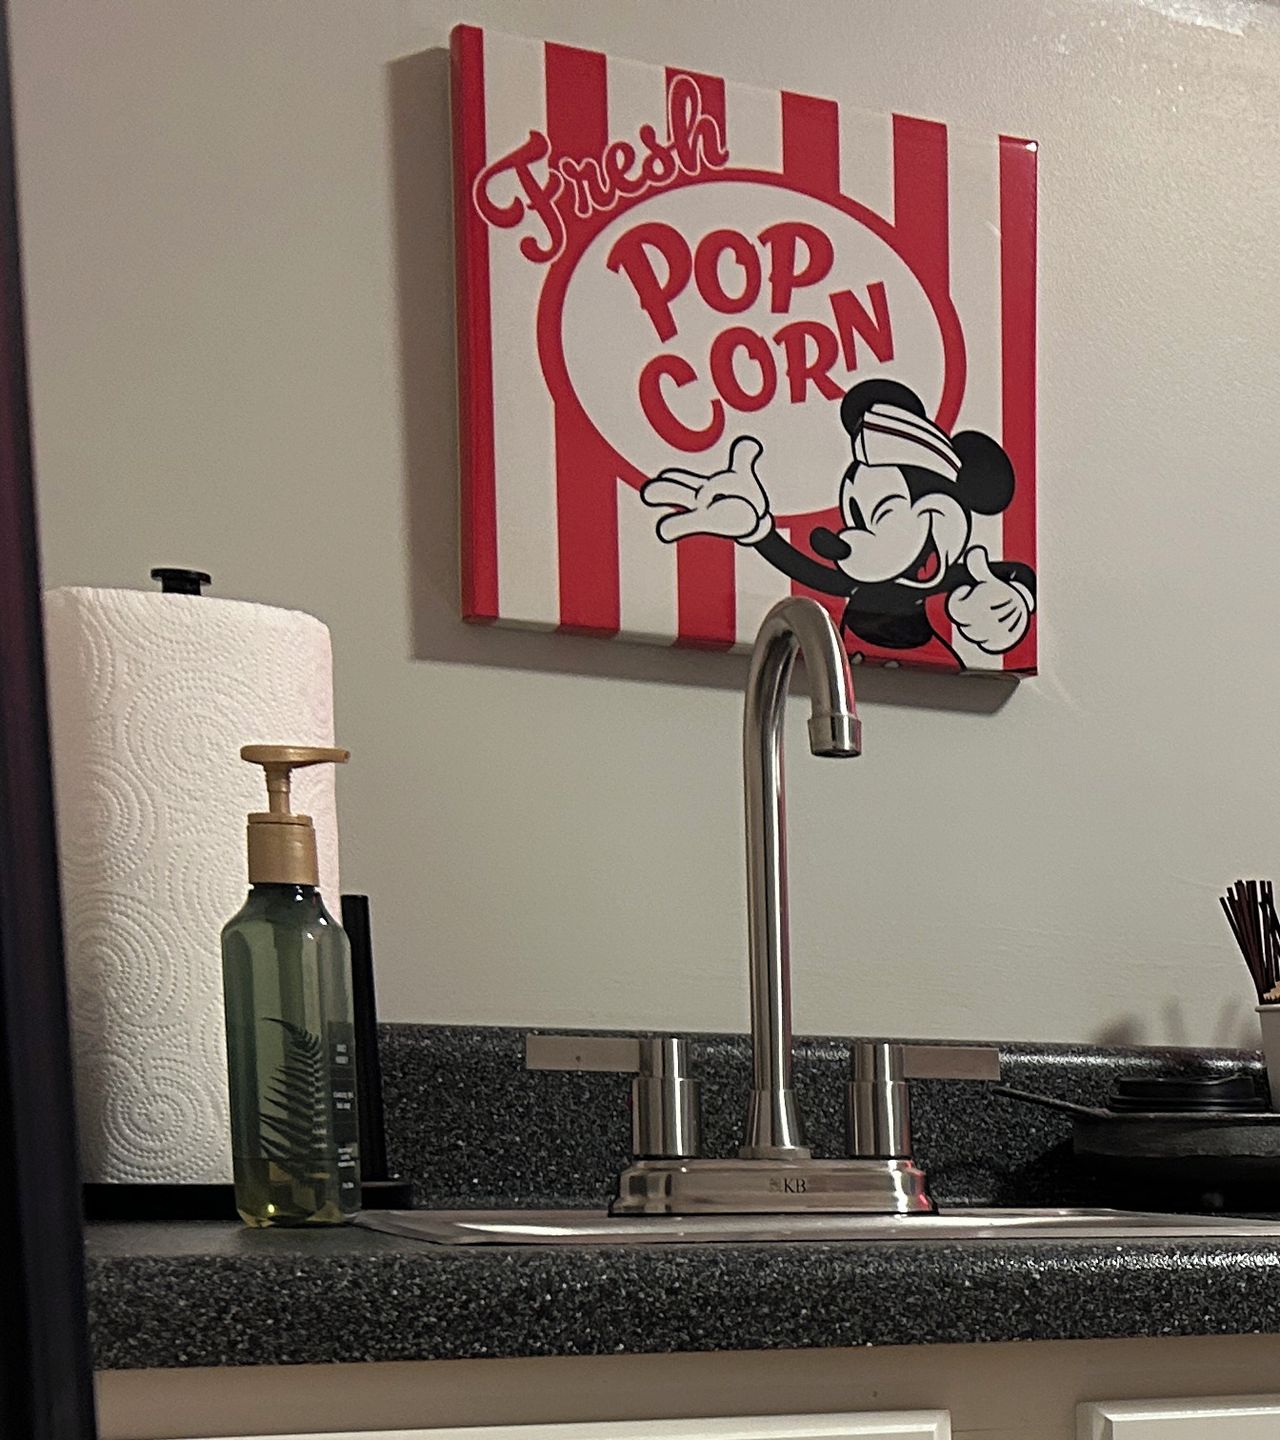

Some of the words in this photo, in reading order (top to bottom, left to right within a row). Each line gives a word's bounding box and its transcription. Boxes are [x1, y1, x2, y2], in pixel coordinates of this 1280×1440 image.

[472, 75, 730, 265] Fresh
[606, 222, 835, 343] POP
[637, 281, 895, 453] CORN
